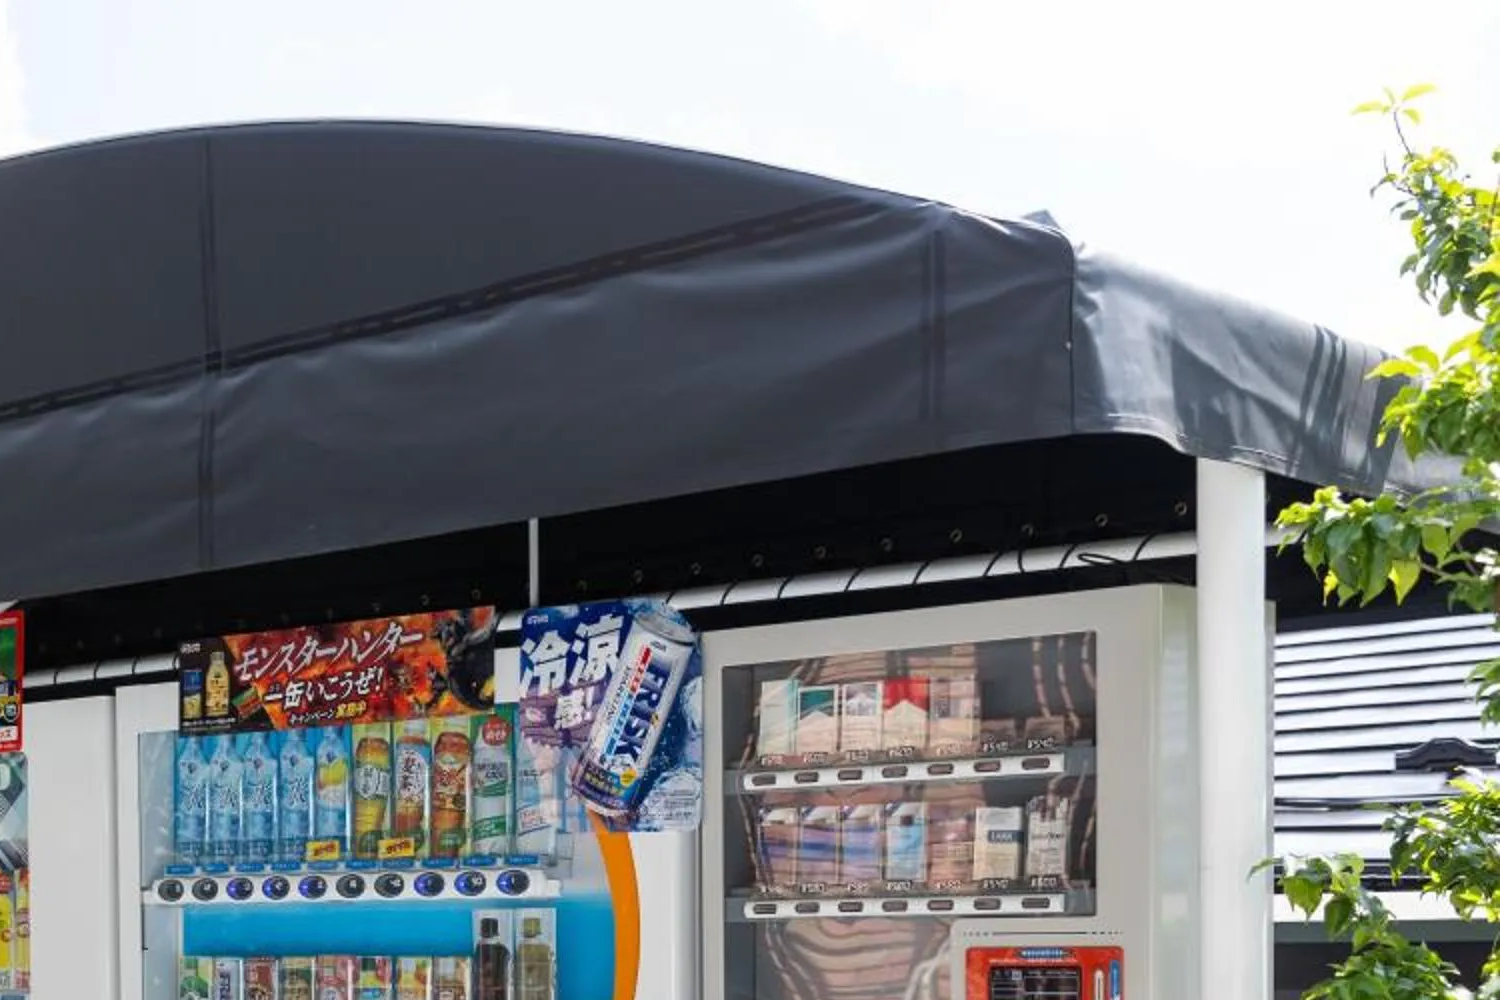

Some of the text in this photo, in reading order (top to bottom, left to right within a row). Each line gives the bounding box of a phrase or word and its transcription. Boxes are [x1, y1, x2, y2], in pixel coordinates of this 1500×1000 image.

[235, 621, 424, 682] モンスターハンター
